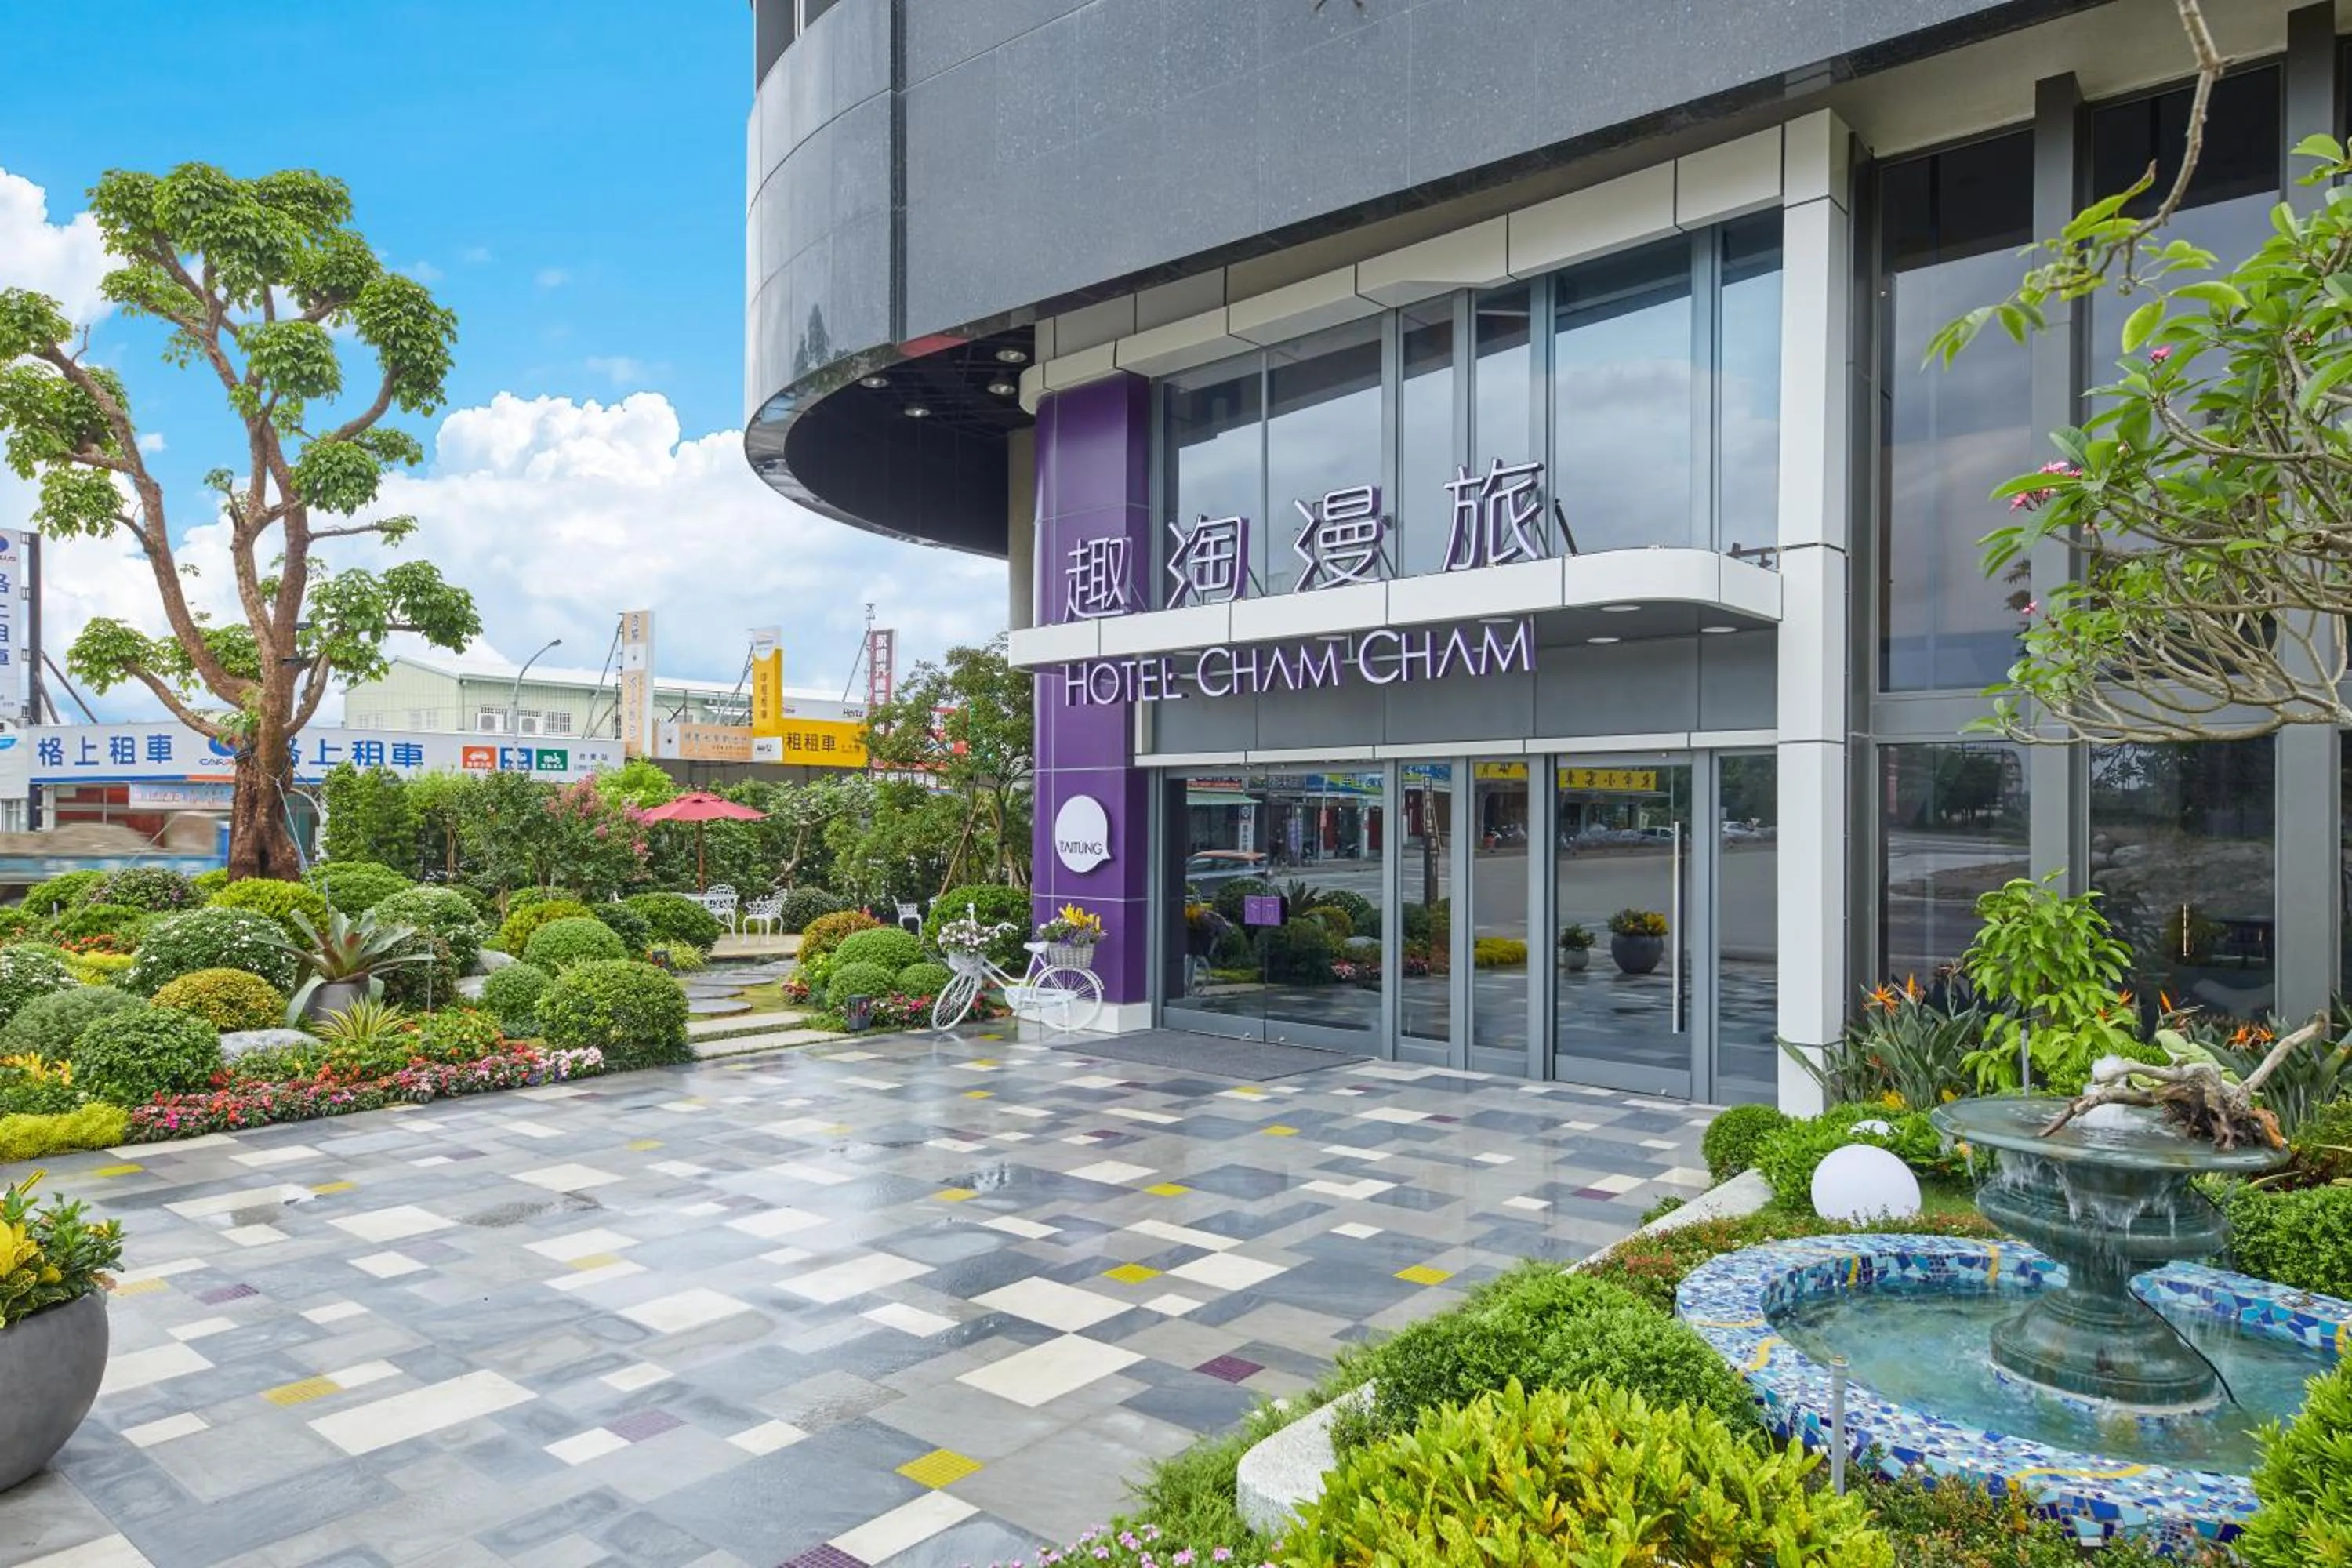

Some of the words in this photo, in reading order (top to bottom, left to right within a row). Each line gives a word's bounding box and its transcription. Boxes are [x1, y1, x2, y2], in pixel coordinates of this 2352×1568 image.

[1063, 459, 1545, 622] 趣淘漫旅
[1065, 659, 1187, 706] HOTEL
[1197, 639, 1344, 697] CHAM
[1359, 619, 1535, 684] CHAM
[38, 734, 173, 767] 格上租車
[786, 732, 837, 753] 租租車
[1059, 840, 1103, 855] TAITUNG
